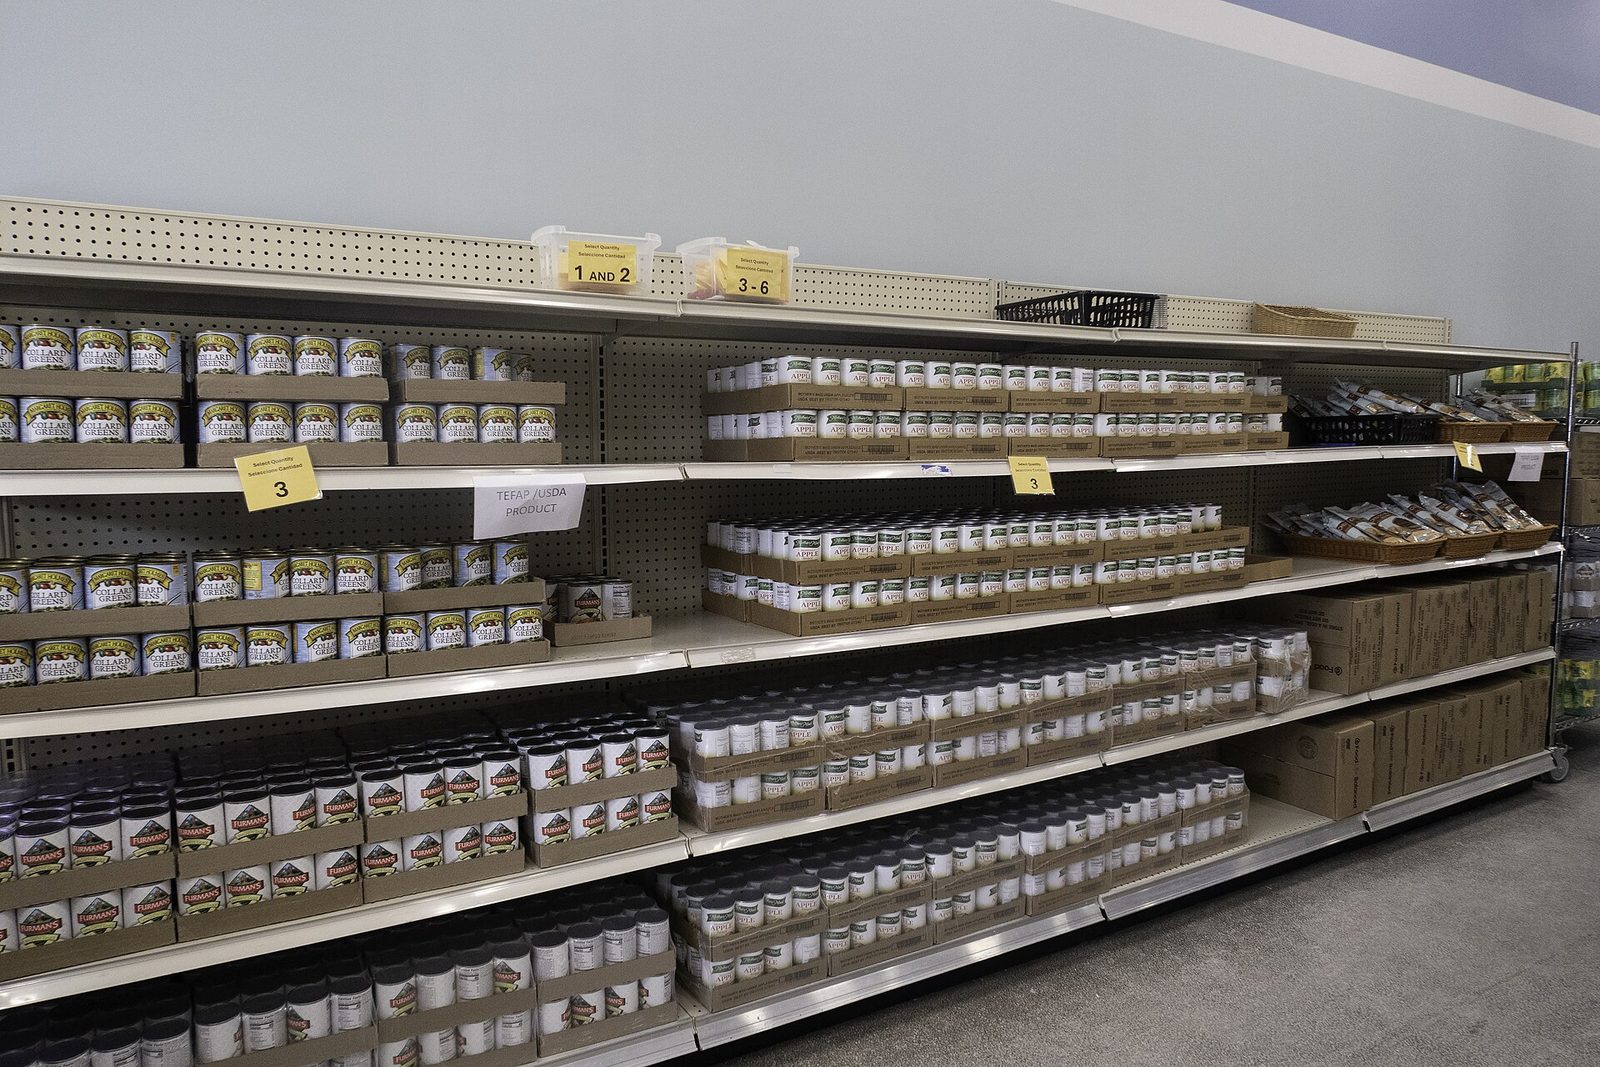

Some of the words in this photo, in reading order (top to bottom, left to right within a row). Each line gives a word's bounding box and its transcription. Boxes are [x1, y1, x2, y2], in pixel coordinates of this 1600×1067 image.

[574, 265, 582, 280] 1
[590, 272, 615, 282] AND
[620, 268, 630, 282] 2
[739, 278, 748, 292] 3
[760, 281, 768, 294] 6
[278, 463, 303, 471] Cantidad
[274, 481, 289, 497] 3
[1030, 478, 1038, 489] 3
[496, 490, 530, 501] TEFAP
[532, 488, 567, 500] /USDA
[506, 504, 557, 517] PRODUCT
[150, 653, 187, 661] COLLARD
[40, 661, 79, 669] COLLARD
[95, 664, 128, 673] GREENS
[153, 660, 186, 668] GREENS
[42, 669, 76, 677] GREENS
[23, 851, 63, 864] FURMAN'S
[80, 908, 117, 921] FURMAN'S
